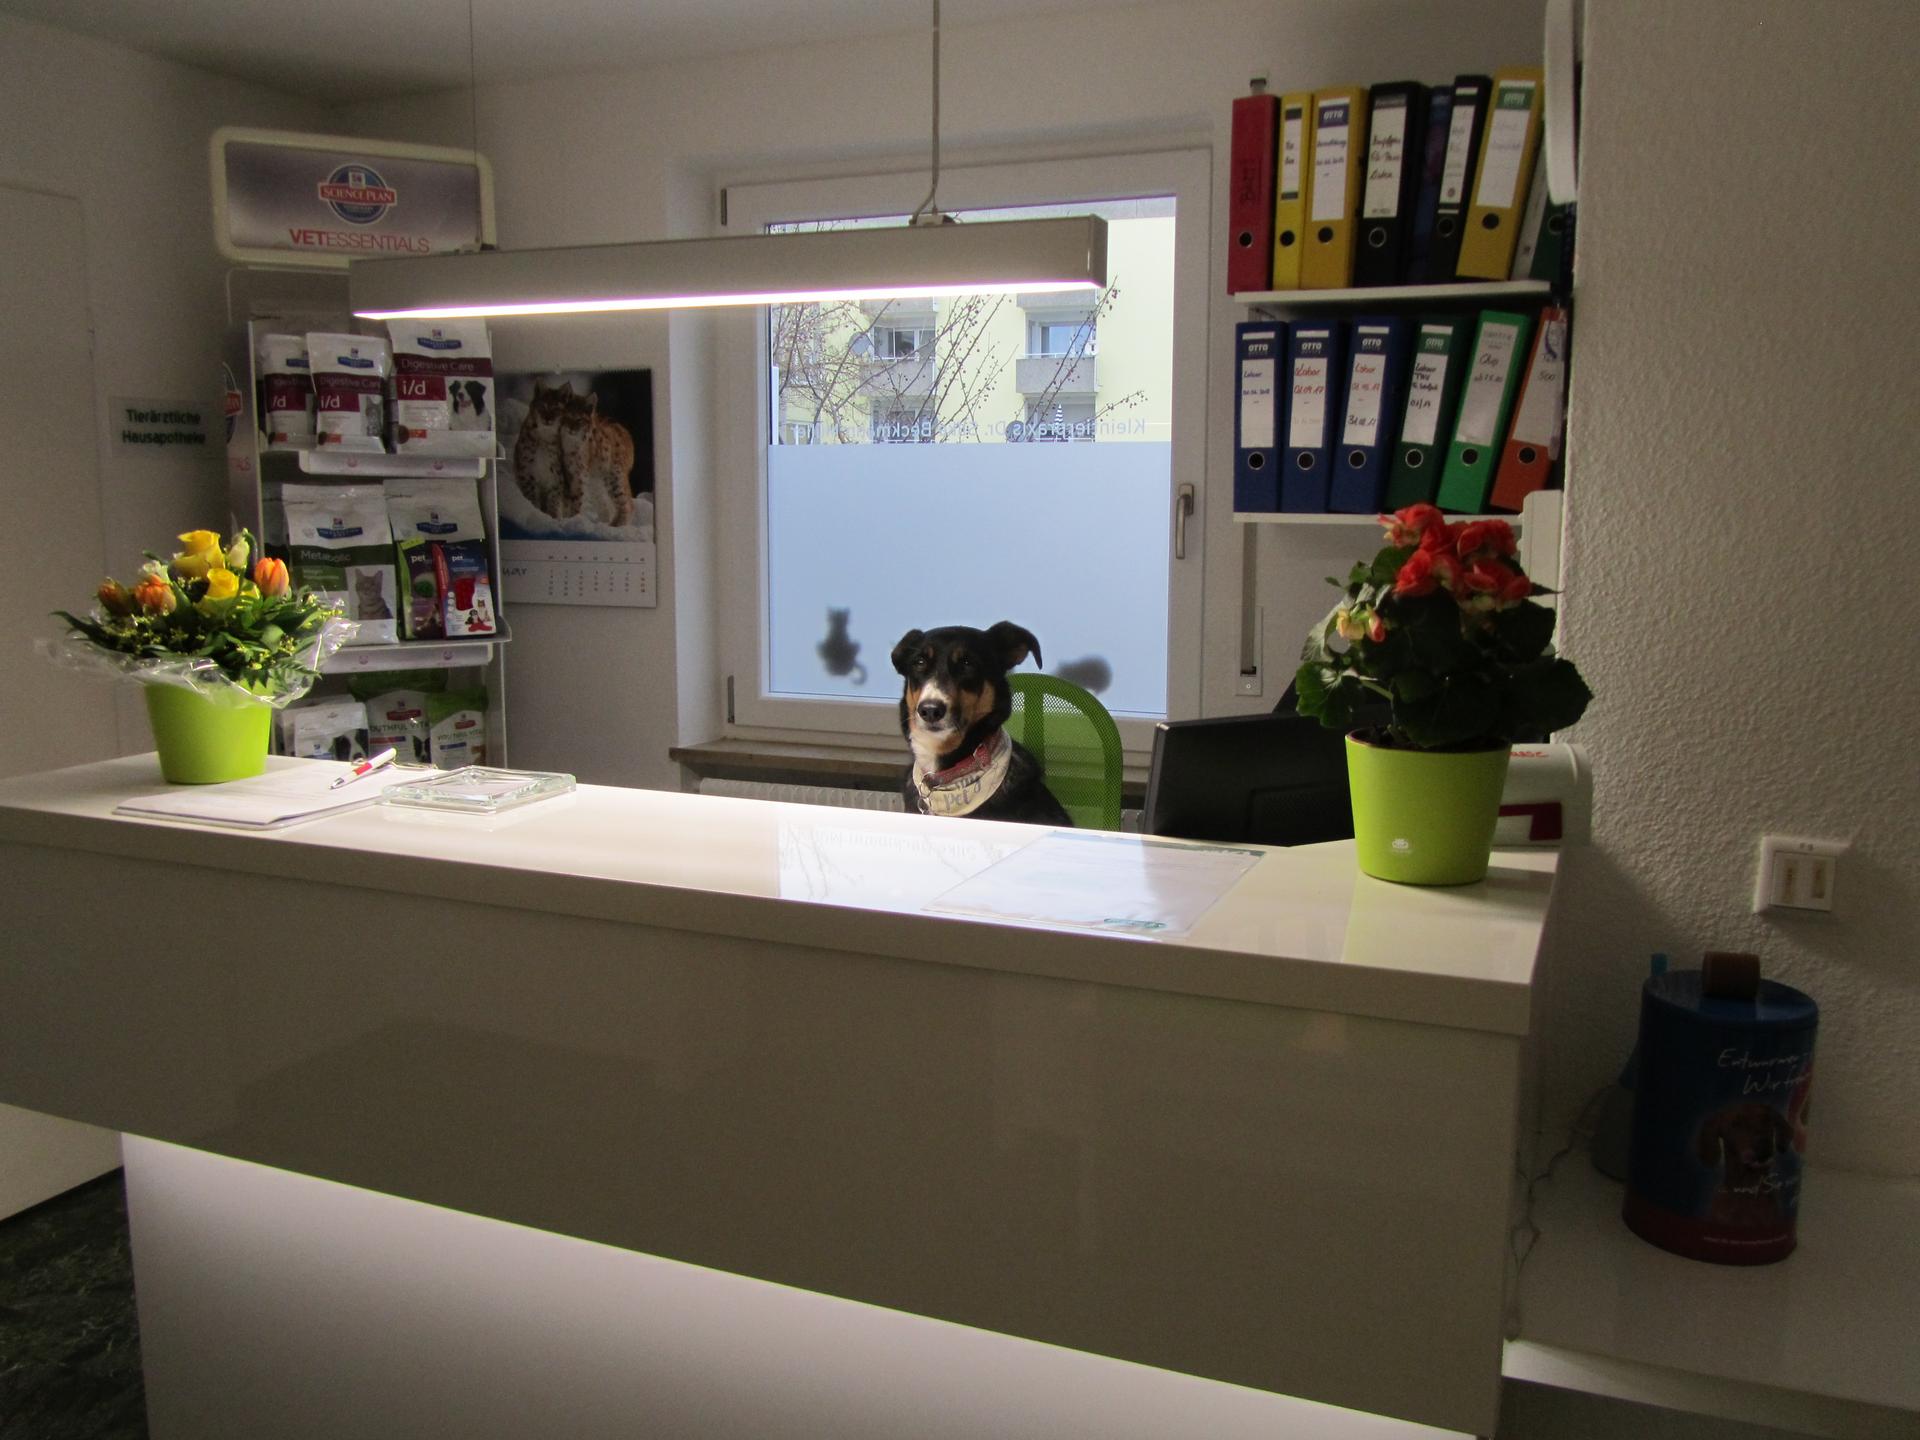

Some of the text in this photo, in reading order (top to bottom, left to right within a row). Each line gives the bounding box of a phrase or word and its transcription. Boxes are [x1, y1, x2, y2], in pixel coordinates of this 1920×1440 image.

[367, 189, 392, 201] PLAN
[1248, 343, 1269, 352] OTTO
[1301, 342, 1322, 350] OTTO
[1362, 338, 1382, 346] OTTO
[450, 361, 474, 371] Care
[402, 380, 426, 395] i/d
[272, 395, 287, 408] /d
[321, 395, 340, 408] i/d
[126, 408, 201, 424] Tierärztliche
[122, 430, 206, 447] Hausapotheke
[369, 722, 408, 733] OUTHFUL
